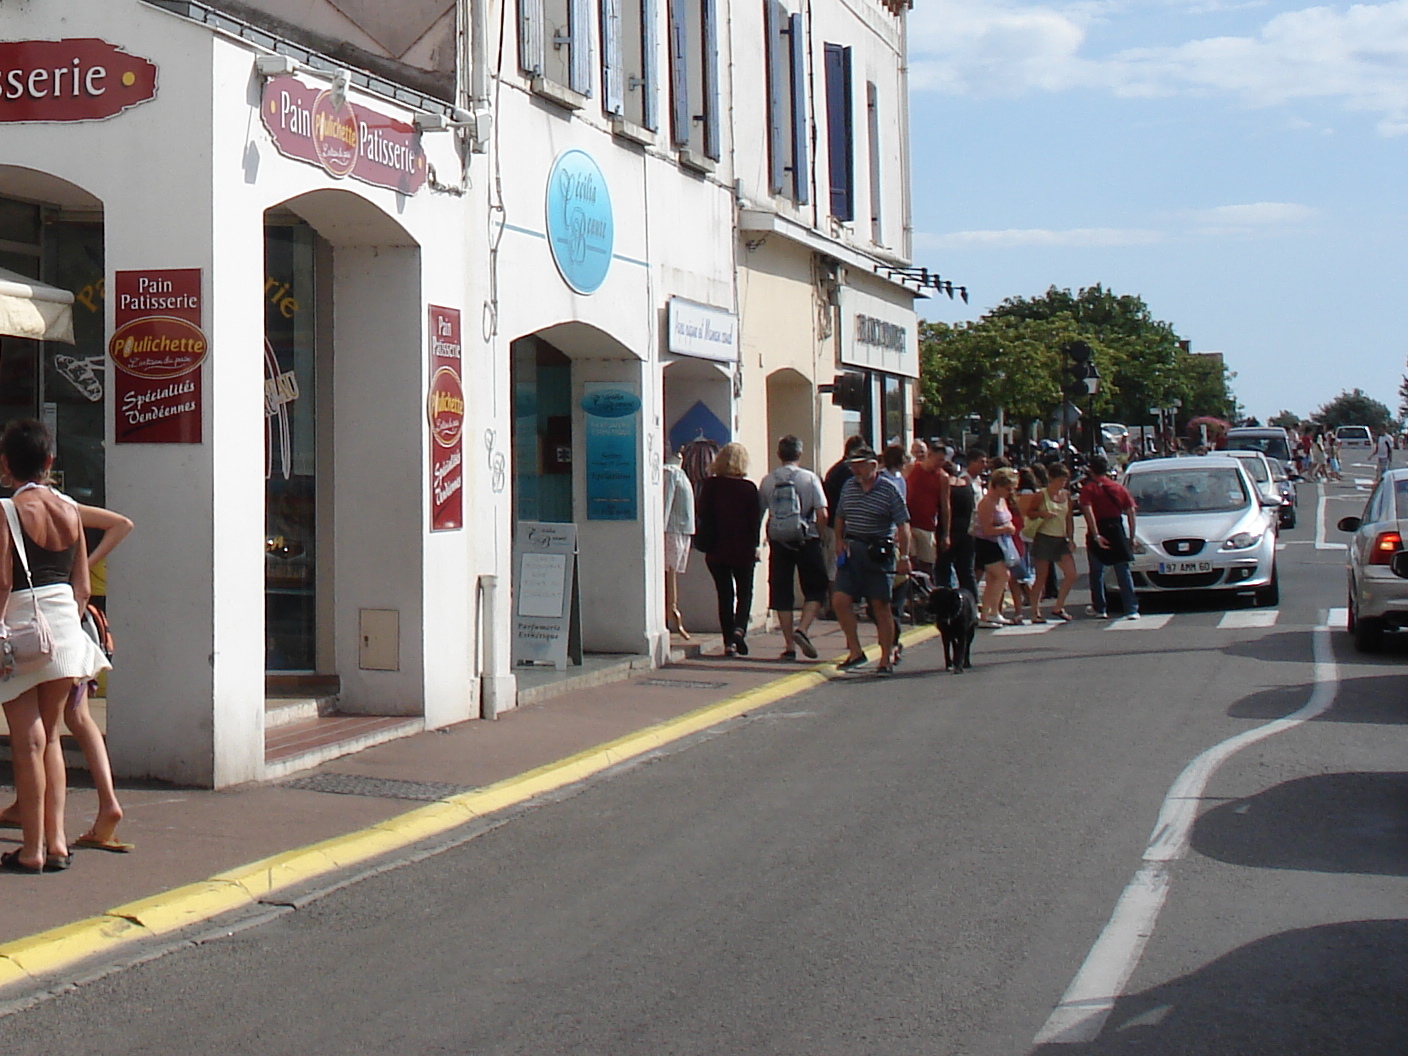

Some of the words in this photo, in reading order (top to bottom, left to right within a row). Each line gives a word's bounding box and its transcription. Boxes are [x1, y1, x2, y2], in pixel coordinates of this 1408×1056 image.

[280, 91, 311, 138] Pain
[359, 121, 415, 175] Patisserie
[139, 277, 172, 293] Pain
[121, 294, 197, 310] Patisserie
[114, 335, 204, 358] Poulichette
[122, 380, 195, 411] Spécialités
